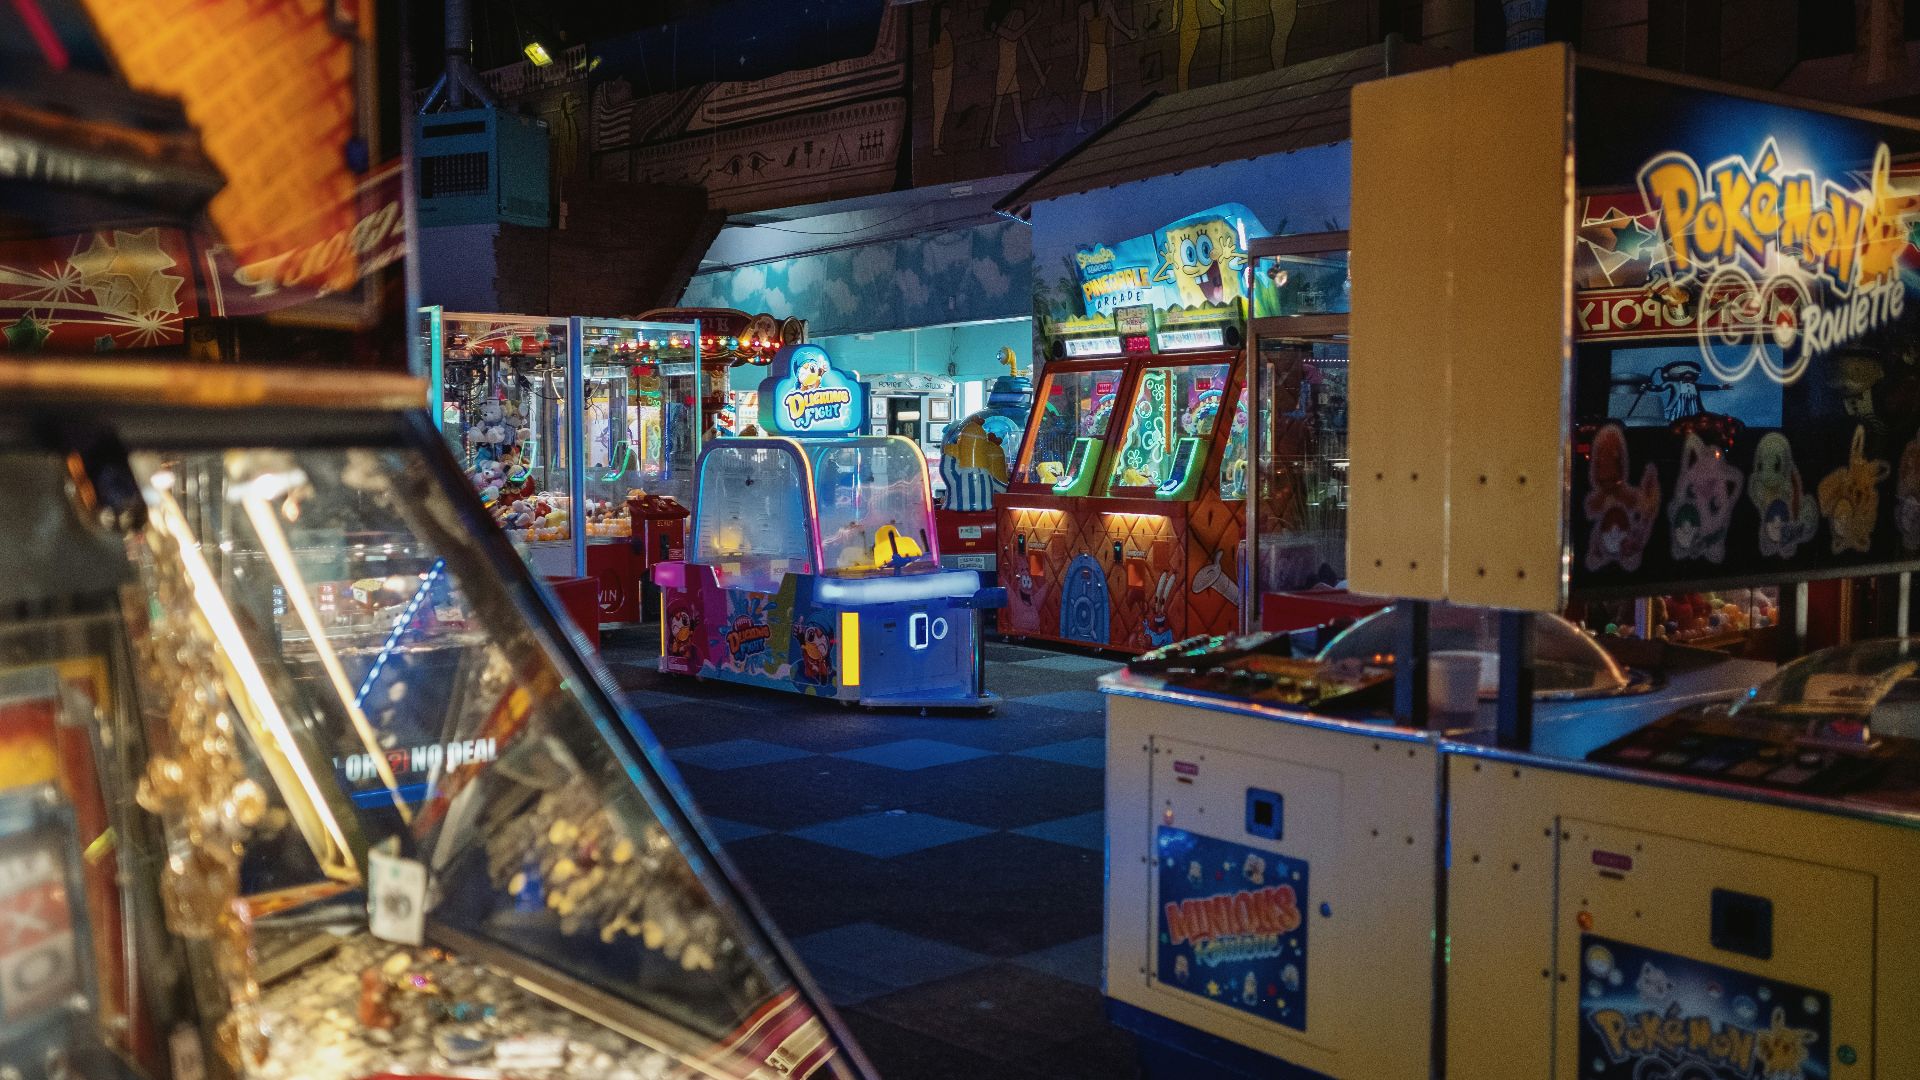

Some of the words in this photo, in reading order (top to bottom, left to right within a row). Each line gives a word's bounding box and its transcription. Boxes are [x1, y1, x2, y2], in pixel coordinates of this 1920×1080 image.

[1083, 267, 1151, 301] PINEAPPLE
[1097, 291, 1141, 309] ARCADE
[1800, 266, 1906, 357] Roulette
[411, 743, 443, 773] NO
[446, 737, 498, 772] DEAL
[1165, 884, 1301, 946] MINIONS
